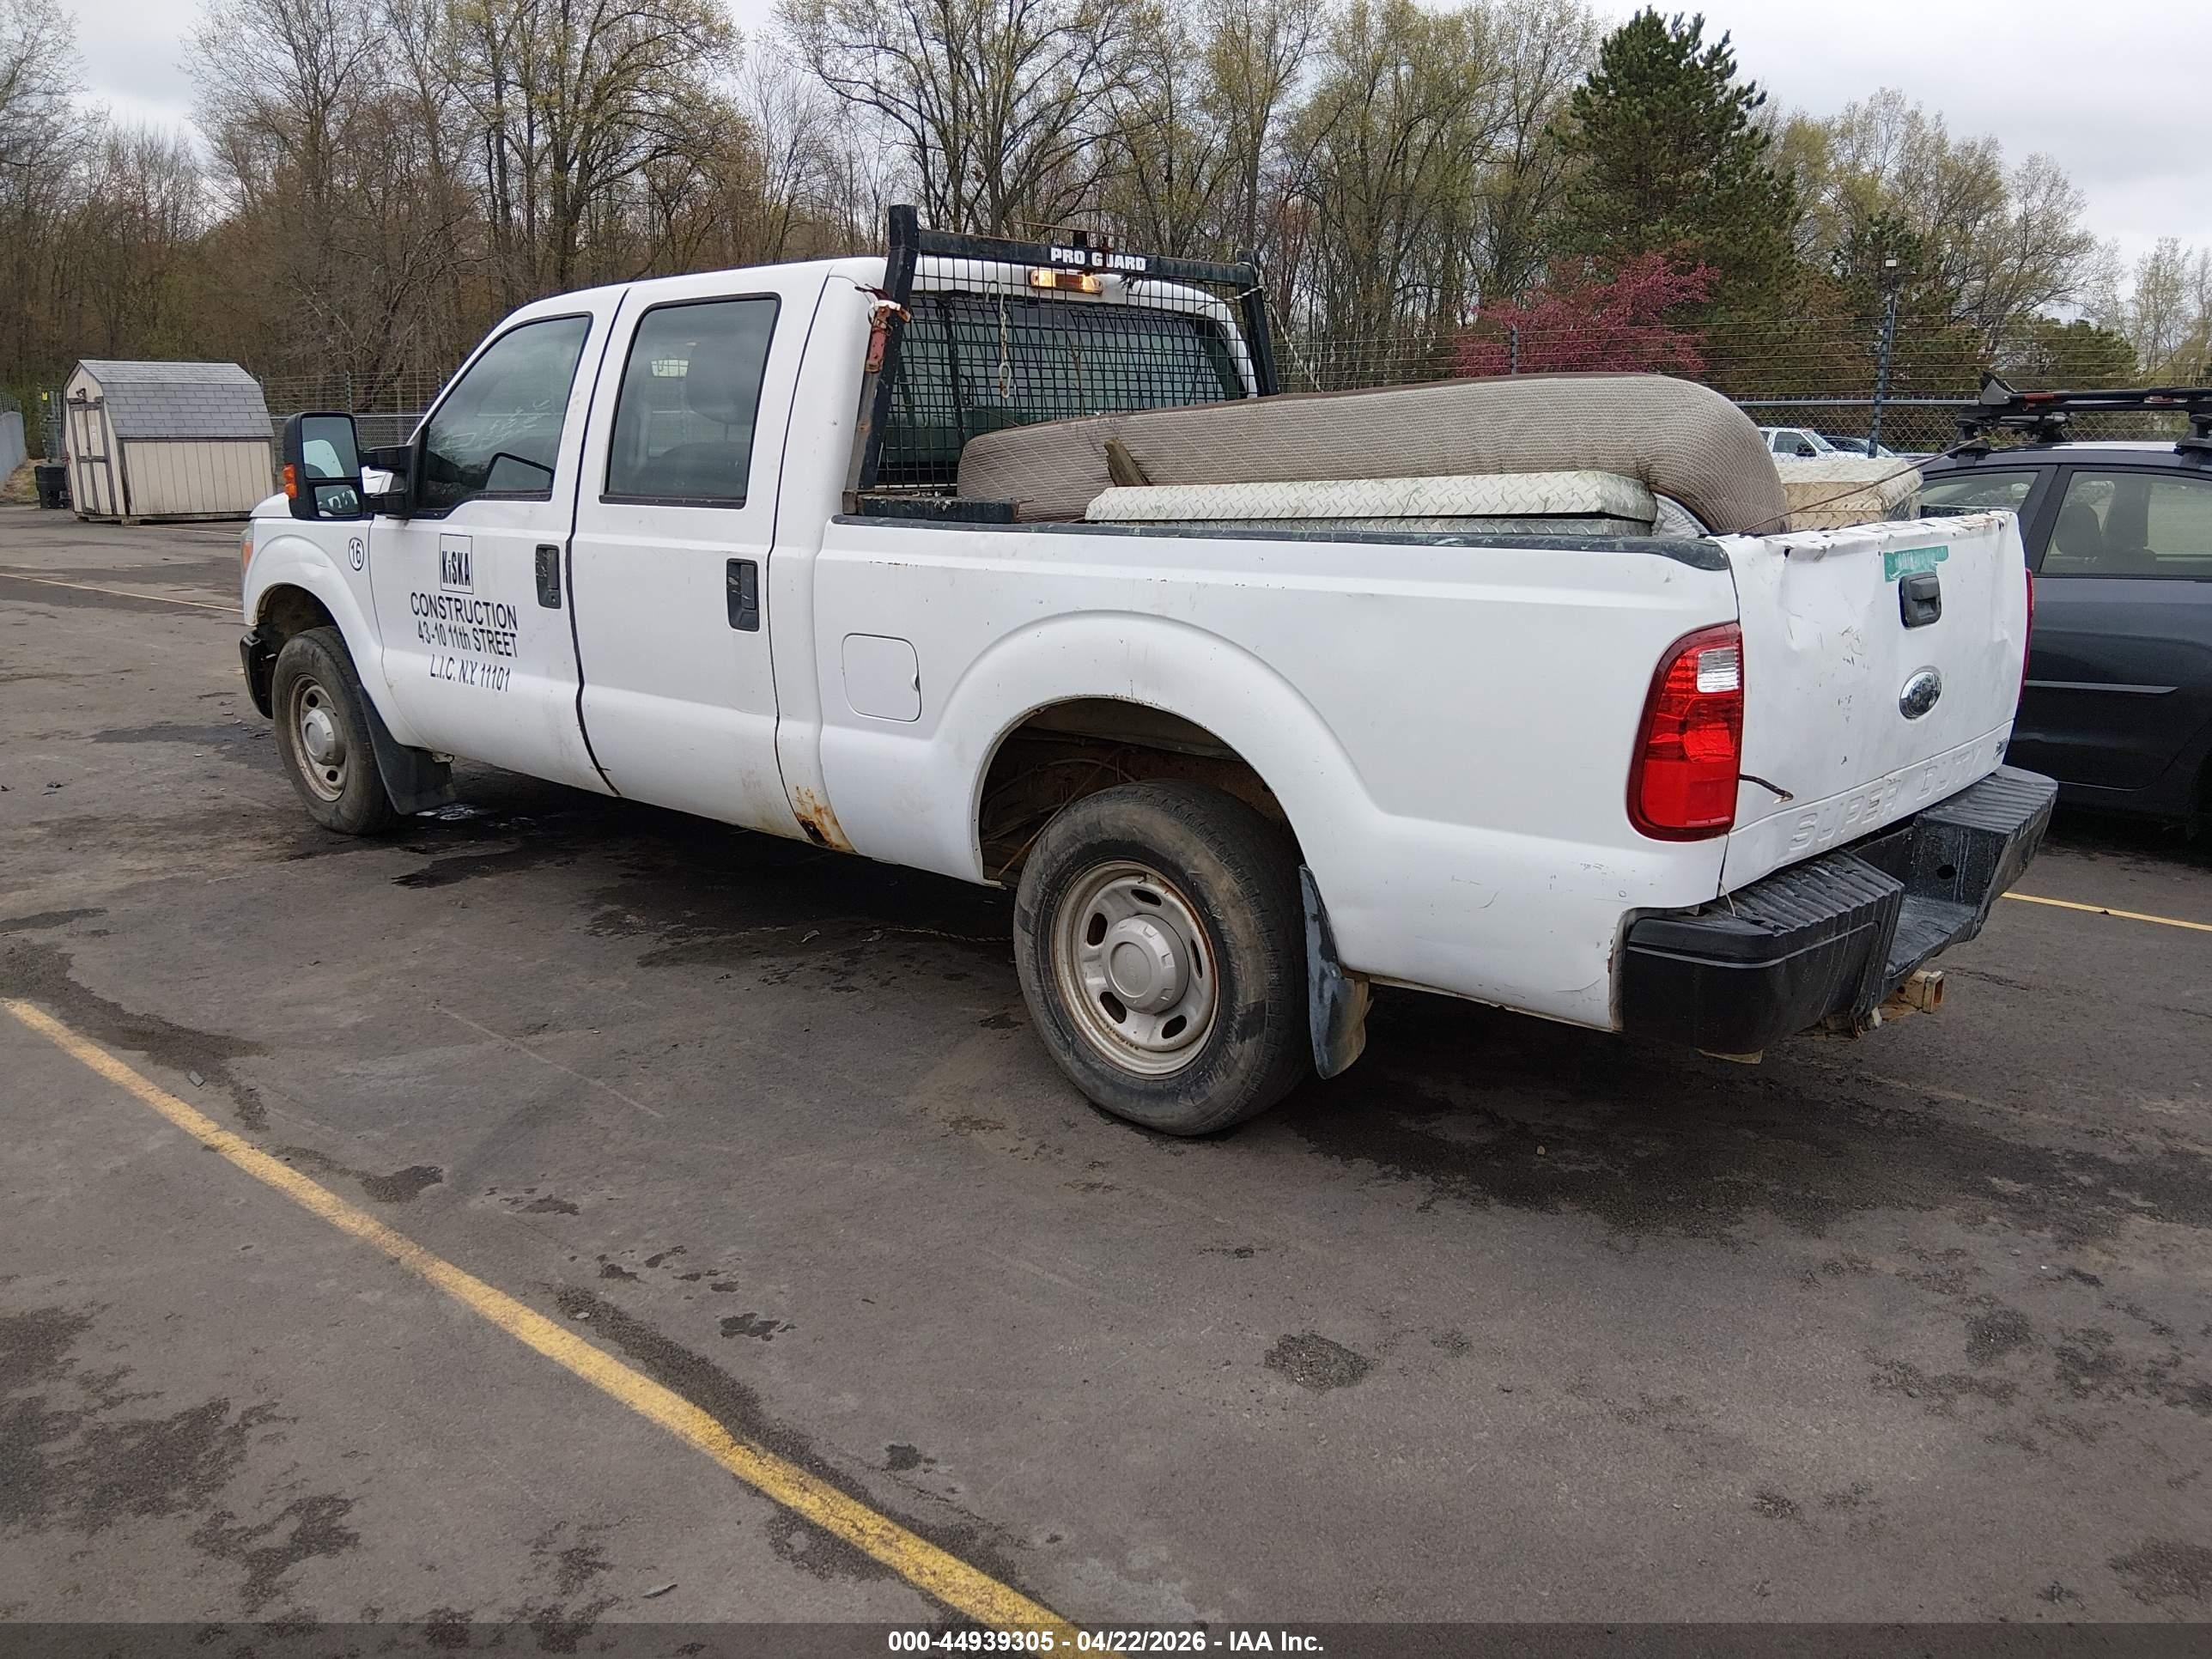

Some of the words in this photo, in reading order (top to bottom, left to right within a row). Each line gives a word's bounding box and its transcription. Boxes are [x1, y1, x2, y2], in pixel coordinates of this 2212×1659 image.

[1050, 246, 1086, 265] PRO
[1091, 252, 1146, 271] GUARD
[350, 541, 362, 564] 16
[410, 592, 518, 631] CONSTRUCTION
[417, 619, 447, 647] 43-10
[448, 623, 471, 651] 11th
[472, 627, 518, 658] STREET
[429, 653, 456, 681] L.I.C.
[480, 663, 511, 692] 11101
[1788, 776, 1903, 852] SUPER
[1916, 744, 1984, 802] DUTY
